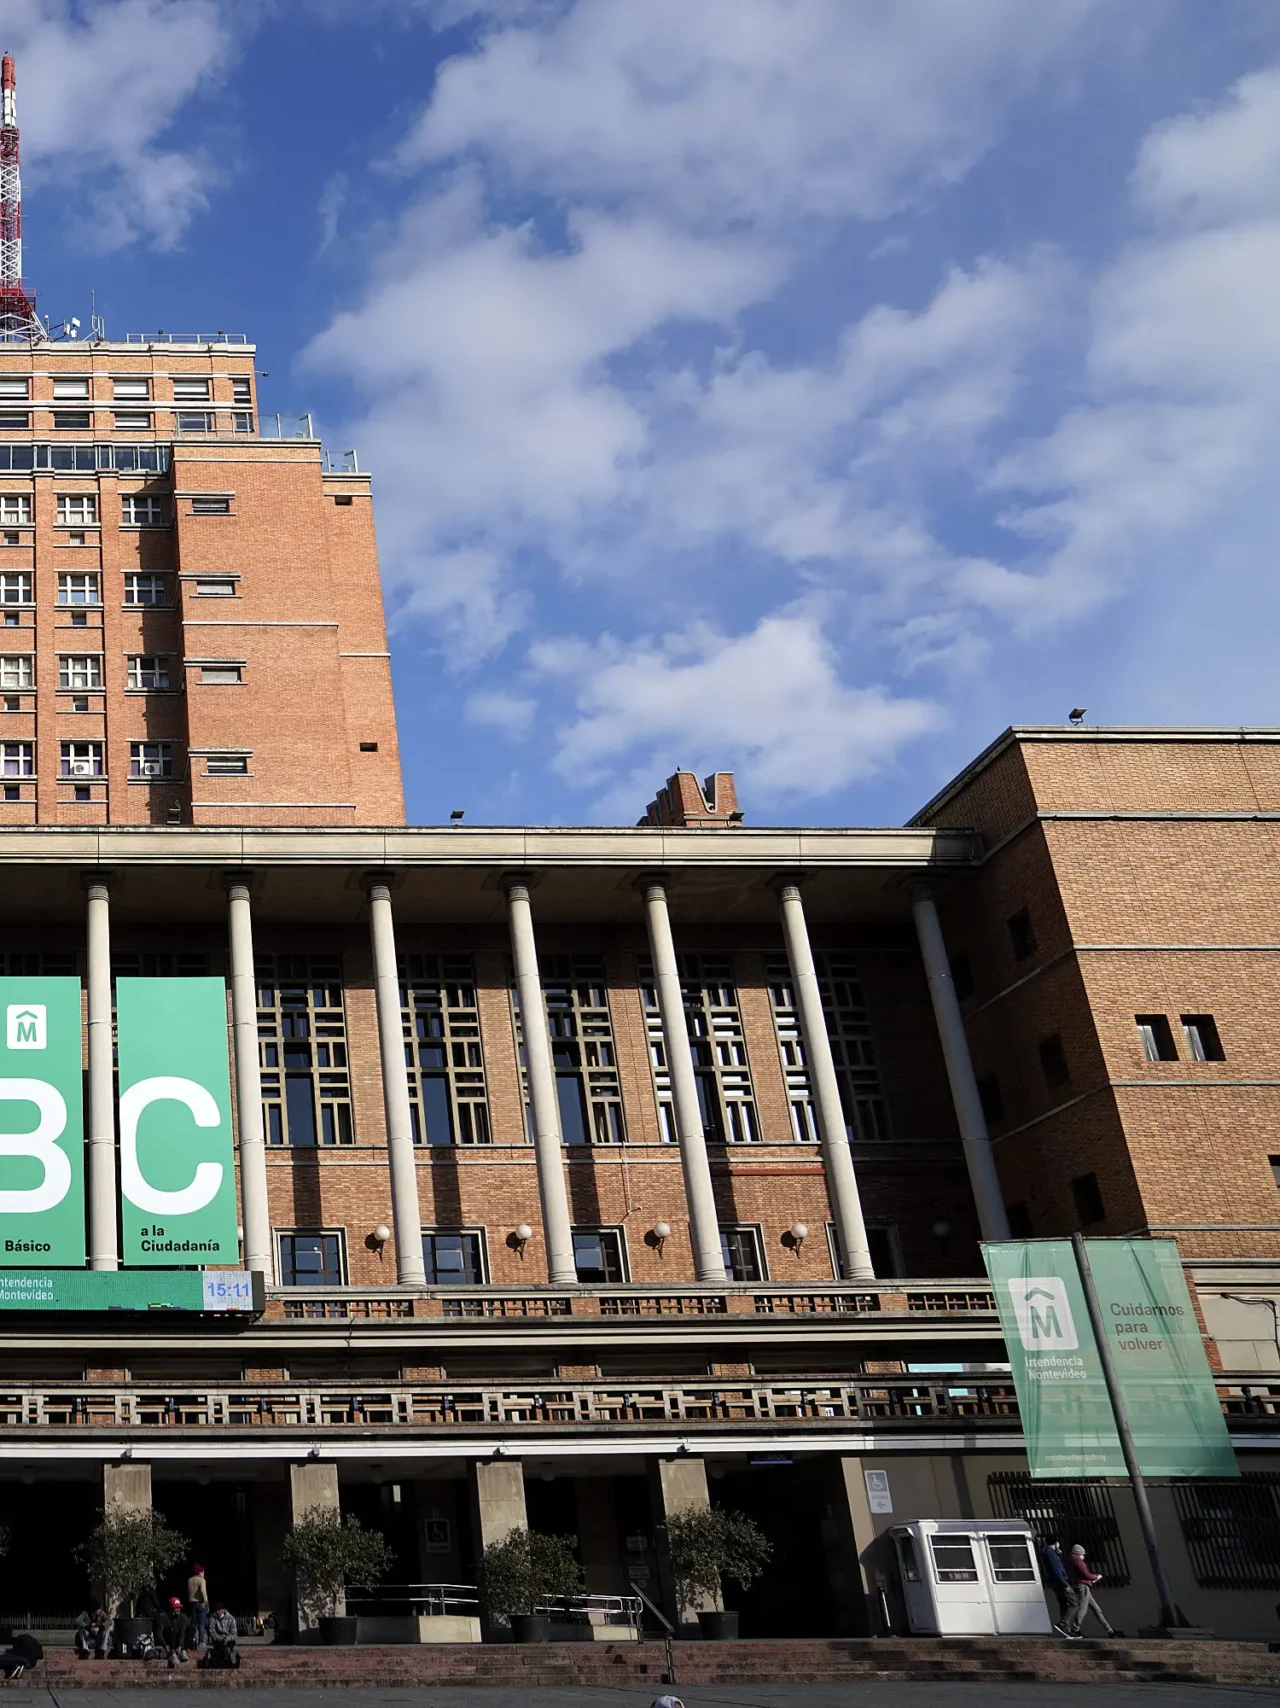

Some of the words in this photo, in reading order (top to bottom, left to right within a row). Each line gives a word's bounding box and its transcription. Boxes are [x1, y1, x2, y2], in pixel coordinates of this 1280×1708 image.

[120, 1075, 223, 1216] C
[141, 1228, 149, 1236] a
[152, 1225, 165, 1236] la
[4, 1239, 51, 1252] Básico
[140, 1239, 220, 1252] Ciudadanía
[207, 1282, 250, 1297] 15:11
[1110, 1302, 1185, 1316] Cuidarnos
[1115, 1322, 1149, 1336] para
[1119, 1337, 1163, 1350] volver
[1025, 1356, 1083, 1368] Intendencia
[1028, 1369, 1087, 1380] Montevideo
